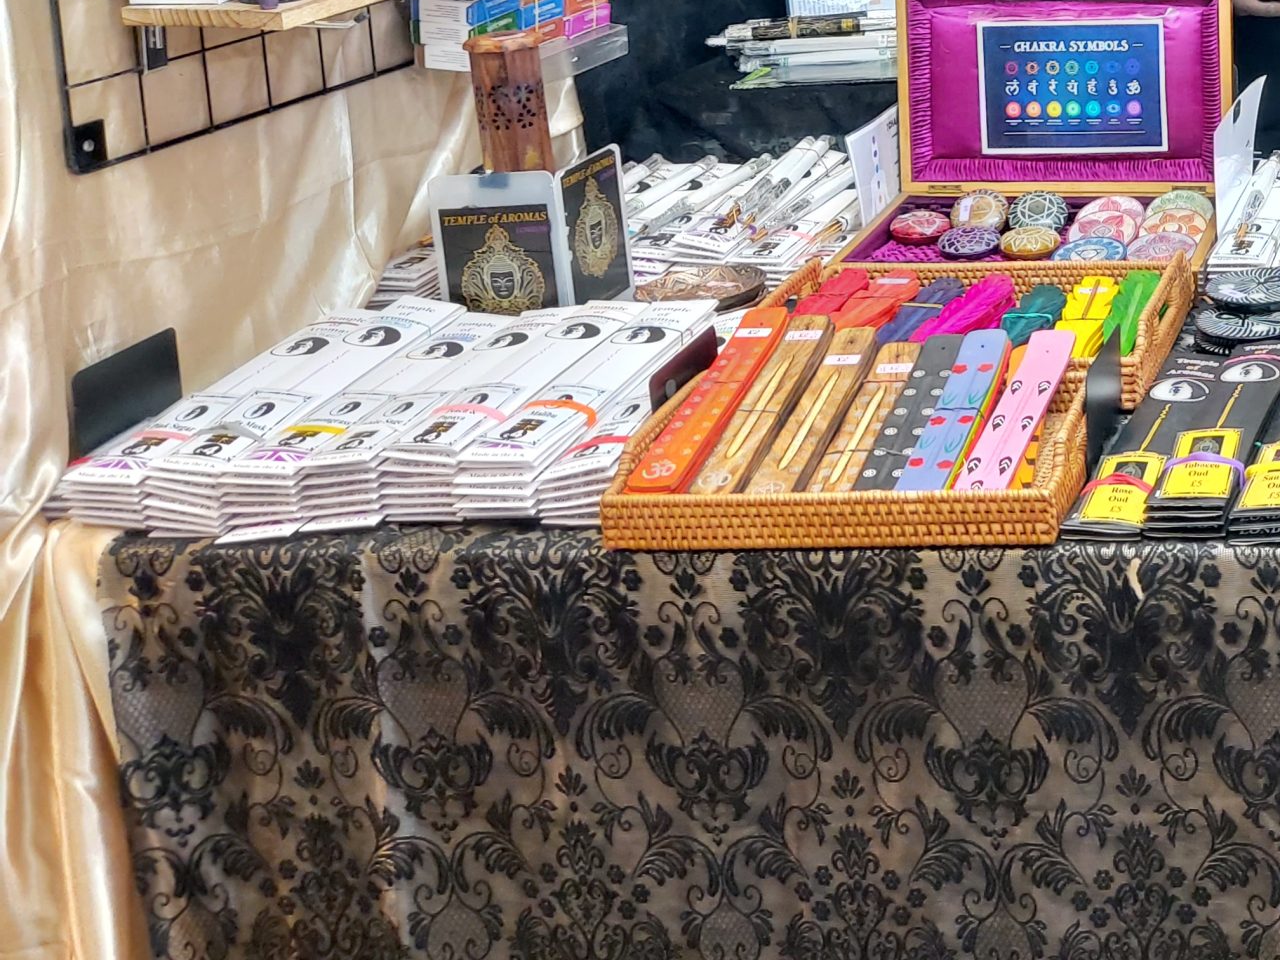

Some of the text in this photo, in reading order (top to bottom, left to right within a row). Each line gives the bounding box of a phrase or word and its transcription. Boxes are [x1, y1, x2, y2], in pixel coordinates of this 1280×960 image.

[1013, 40, 1129, 53] CHAKRA SYMBOLS
[442, 211, 547, 226] TEMPLE of AROMAS
[1175, 357, 1220, 368] Temple
[1166, 370, 1216, 379] Aromas
